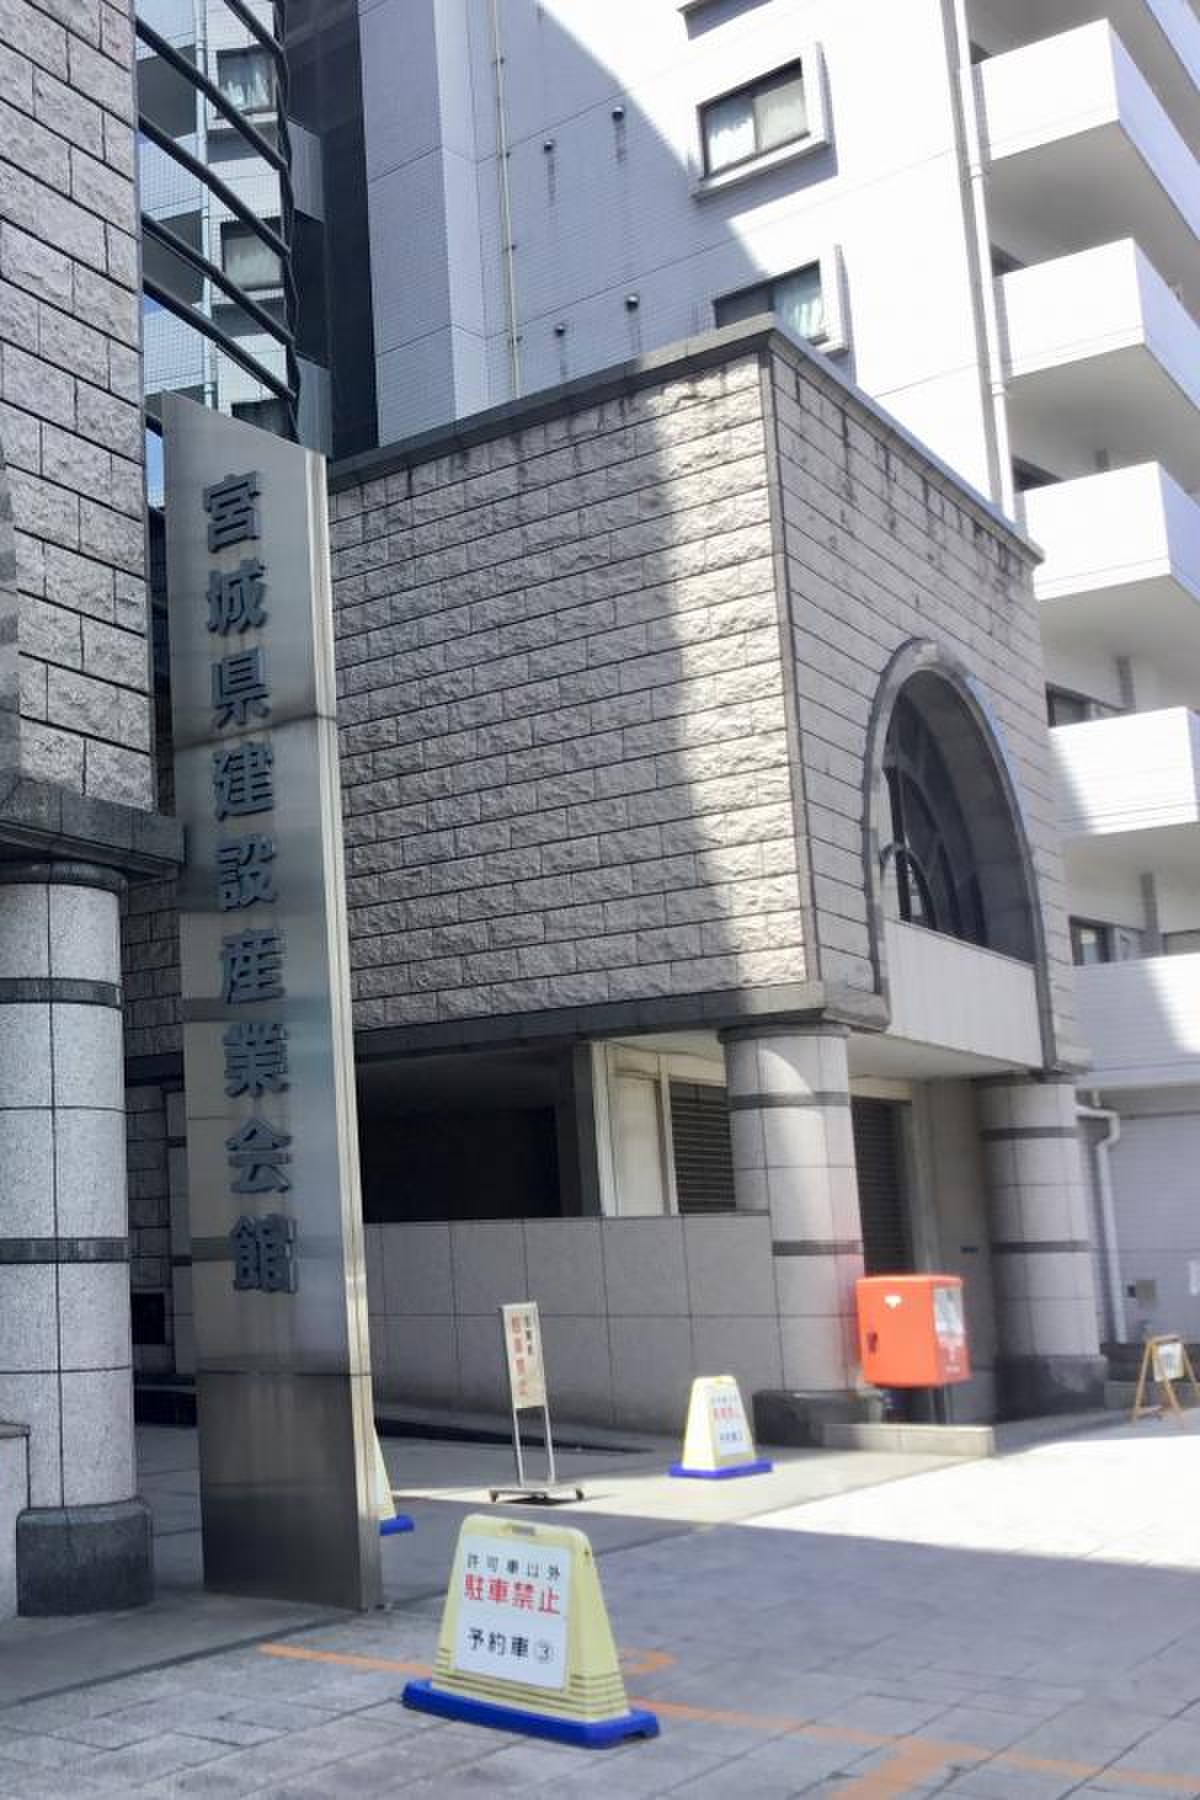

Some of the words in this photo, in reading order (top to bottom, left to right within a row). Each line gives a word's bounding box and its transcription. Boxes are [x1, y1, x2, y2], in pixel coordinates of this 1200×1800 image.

[203, 470, 297, 1294] 宮城県建設産業会館
[464, 1573, 561, 1615] 駐車禁止
